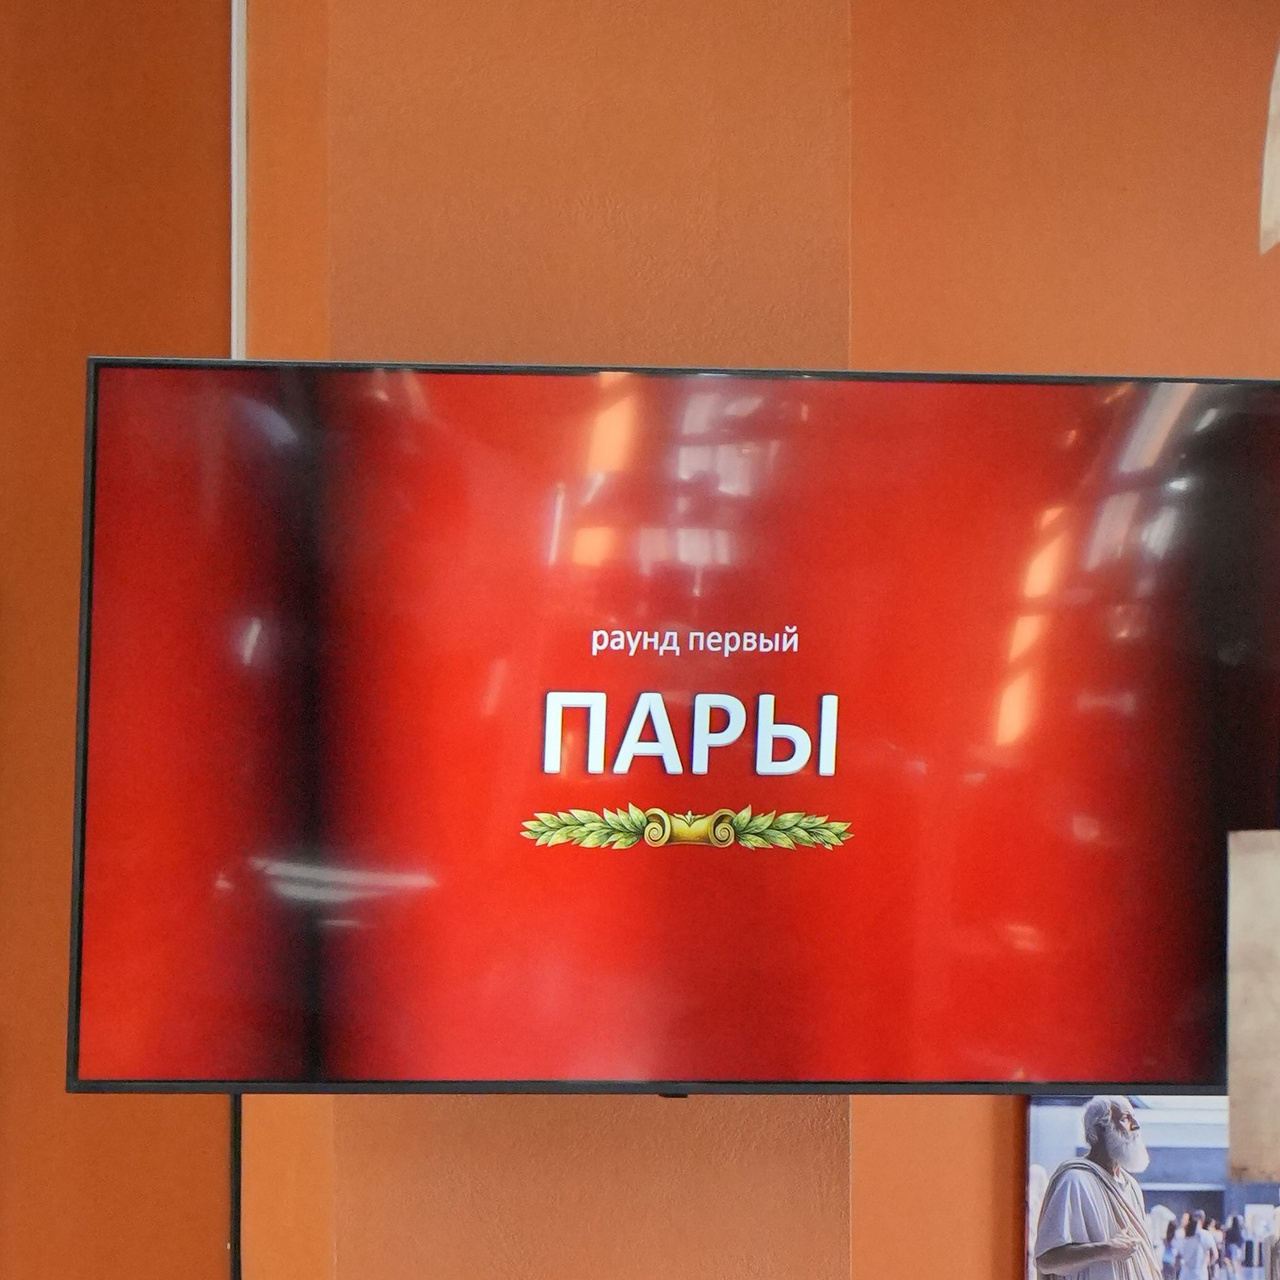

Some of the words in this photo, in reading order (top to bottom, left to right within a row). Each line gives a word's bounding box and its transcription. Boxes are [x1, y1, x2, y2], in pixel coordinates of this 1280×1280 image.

[591, 628, 680, 656] раунд
[688, 625, 799, 657] первый
[543, 691, 839, 776] ПАРЫ
